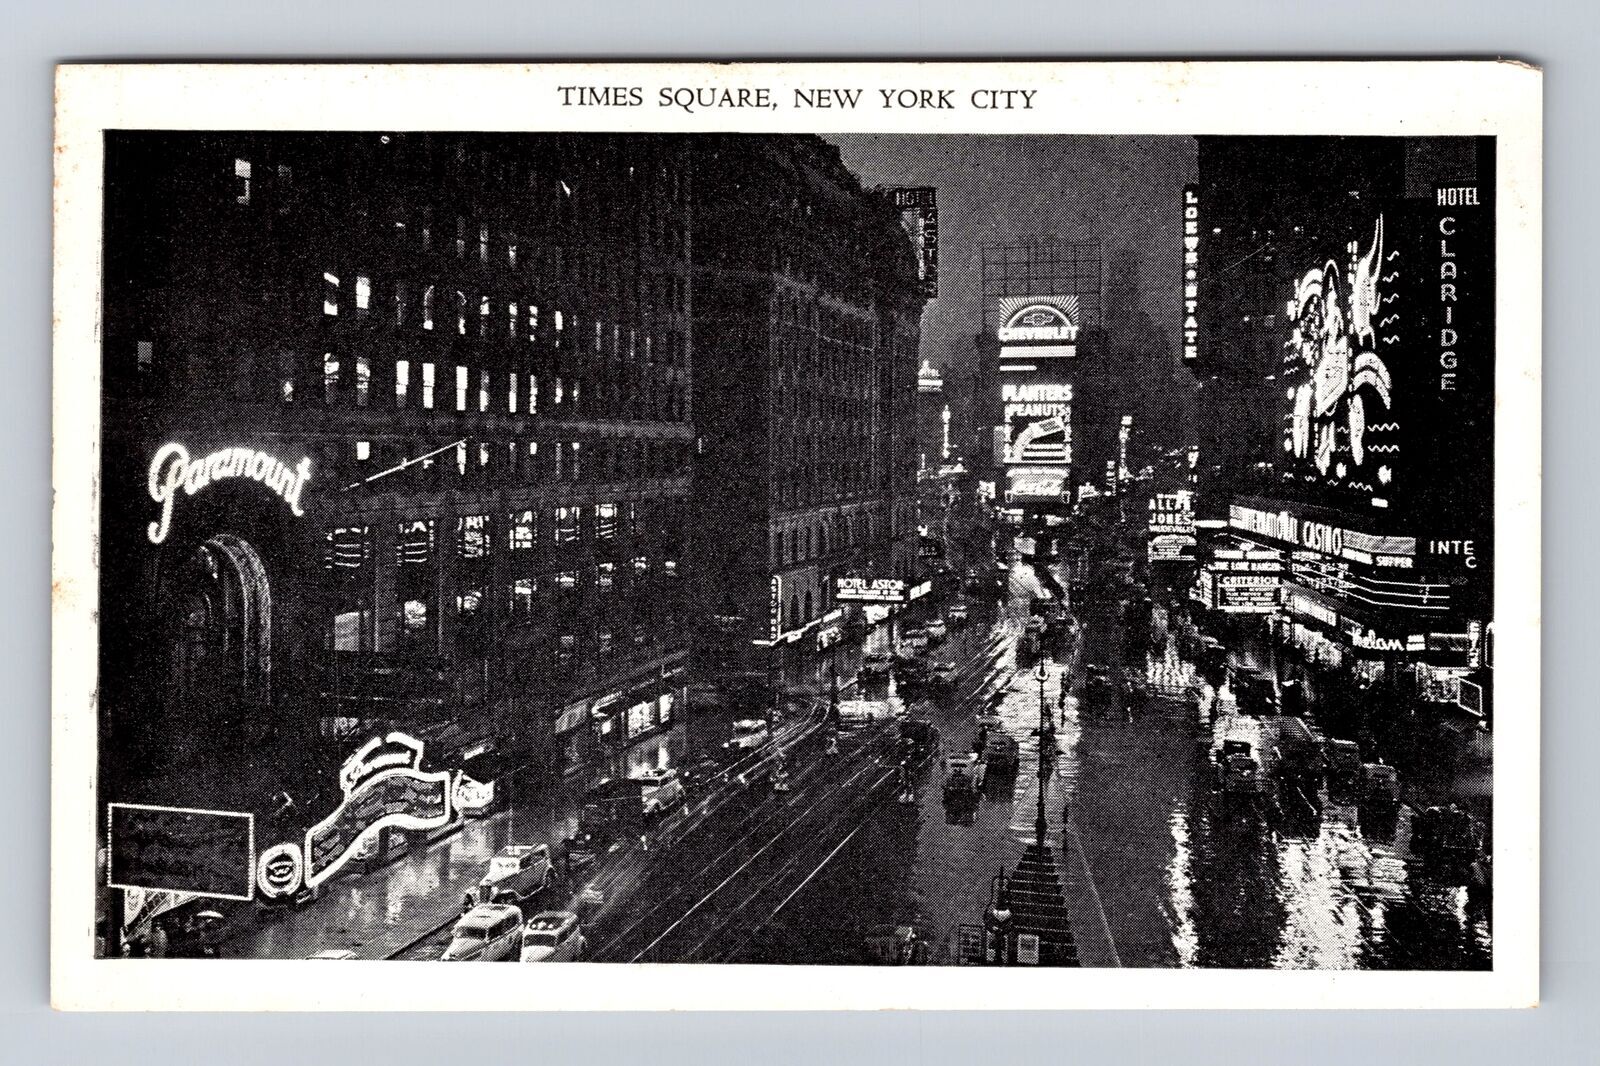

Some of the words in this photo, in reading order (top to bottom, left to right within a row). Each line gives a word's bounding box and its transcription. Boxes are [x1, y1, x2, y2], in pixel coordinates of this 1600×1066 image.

[557, 86, 643, 107] TIMES
[659, 87, 778, 114] SQUARE,
[794, 88, 863, 109] NEW
[879, 89, 955, 109] YORK
[971, 89, 1038, 109] CITY
[1437, 187, 1480, 206] HOTEL
[1439, 216, 1458, 391] CLARIDGE
[1002, 383, 1074, 403] PLANTERS
[1008, 403, 1067, 418] PEANUTS
[147, 442, 312, 544] Paramount
[1148, 512, 1191, 525] JONES
[1302, 520, 1342, 556] CASINO
[837, 578, 868, 589] HOTEL
[871, 579, 904, 591] ASTOR
[1222, 576, 1279, 586] CRITERION
